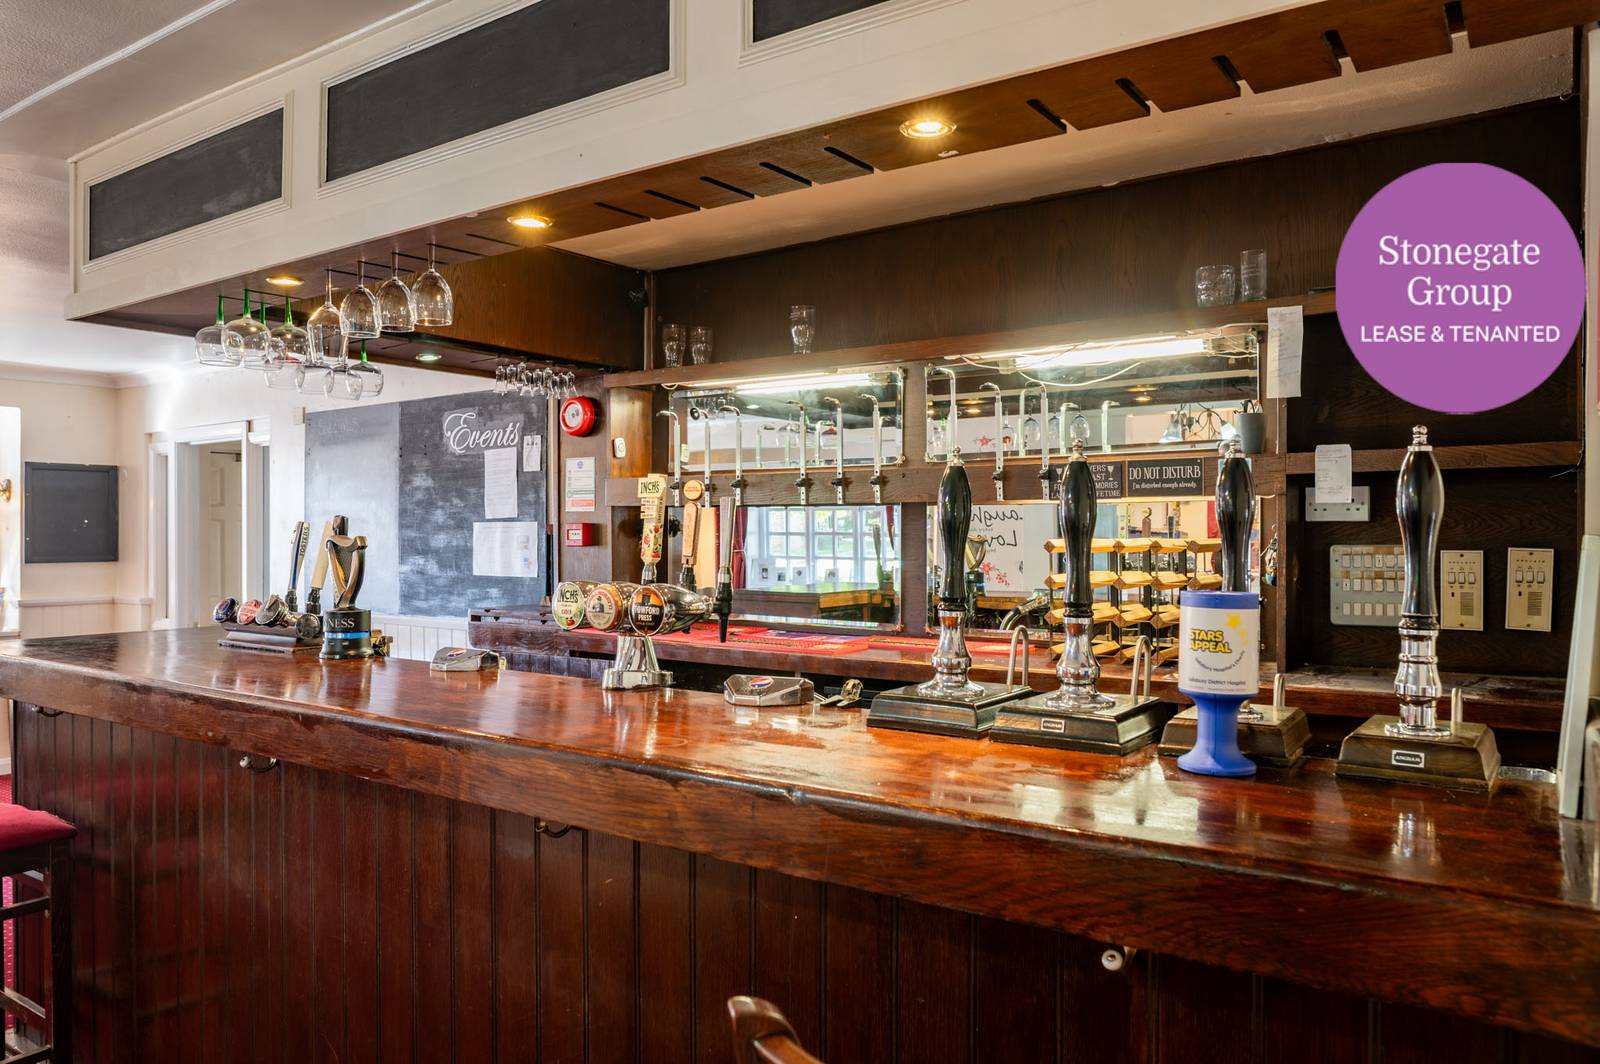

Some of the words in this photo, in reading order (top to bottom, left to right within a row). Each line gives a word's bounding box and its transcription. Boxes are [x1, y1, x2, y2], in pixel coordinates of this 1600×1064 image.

[444, 412, 520, 453] Events
[1129, 467, 1142, 480] DO
[1143, 466, 1161, 480] NOT
[1163, 465, 1201, 479] DISTURB
[1095, 481, 1119, 489] MORIES
[328, 617, 355, 628] NESS
[1189, 628, 1224, 642] STARS
[1189, 640, 1232, 654] APPEAL
